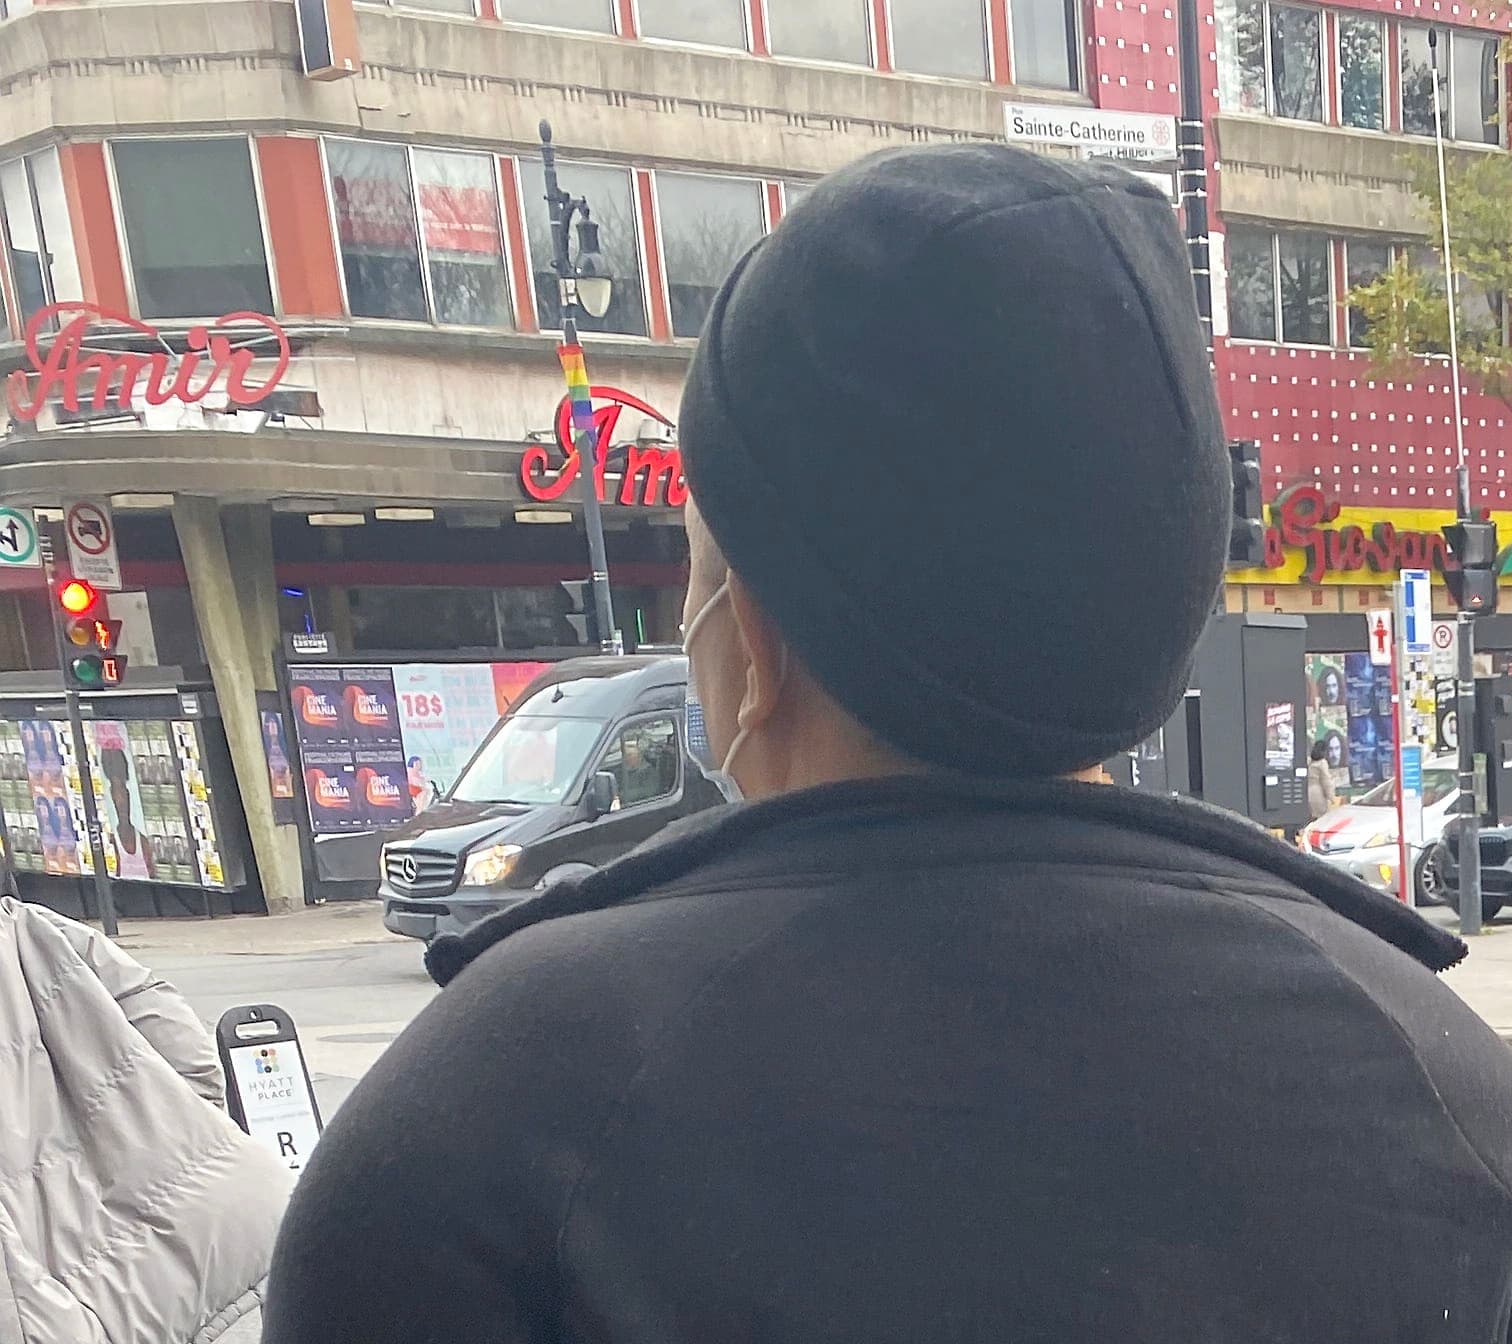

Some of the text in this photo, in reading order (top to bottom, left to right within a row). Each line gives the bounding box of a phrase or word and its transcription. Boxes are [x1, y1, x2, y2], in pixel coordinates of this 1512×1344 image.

[1013, 116, 1146, 144] Sainte-Catherine
[7, 301, 290, 422] Amir
[402, 693, 443, 717] 18$
[248, 1076, 294, 1092] HYATT
[257, 1088, 293, 1101] PLACE
